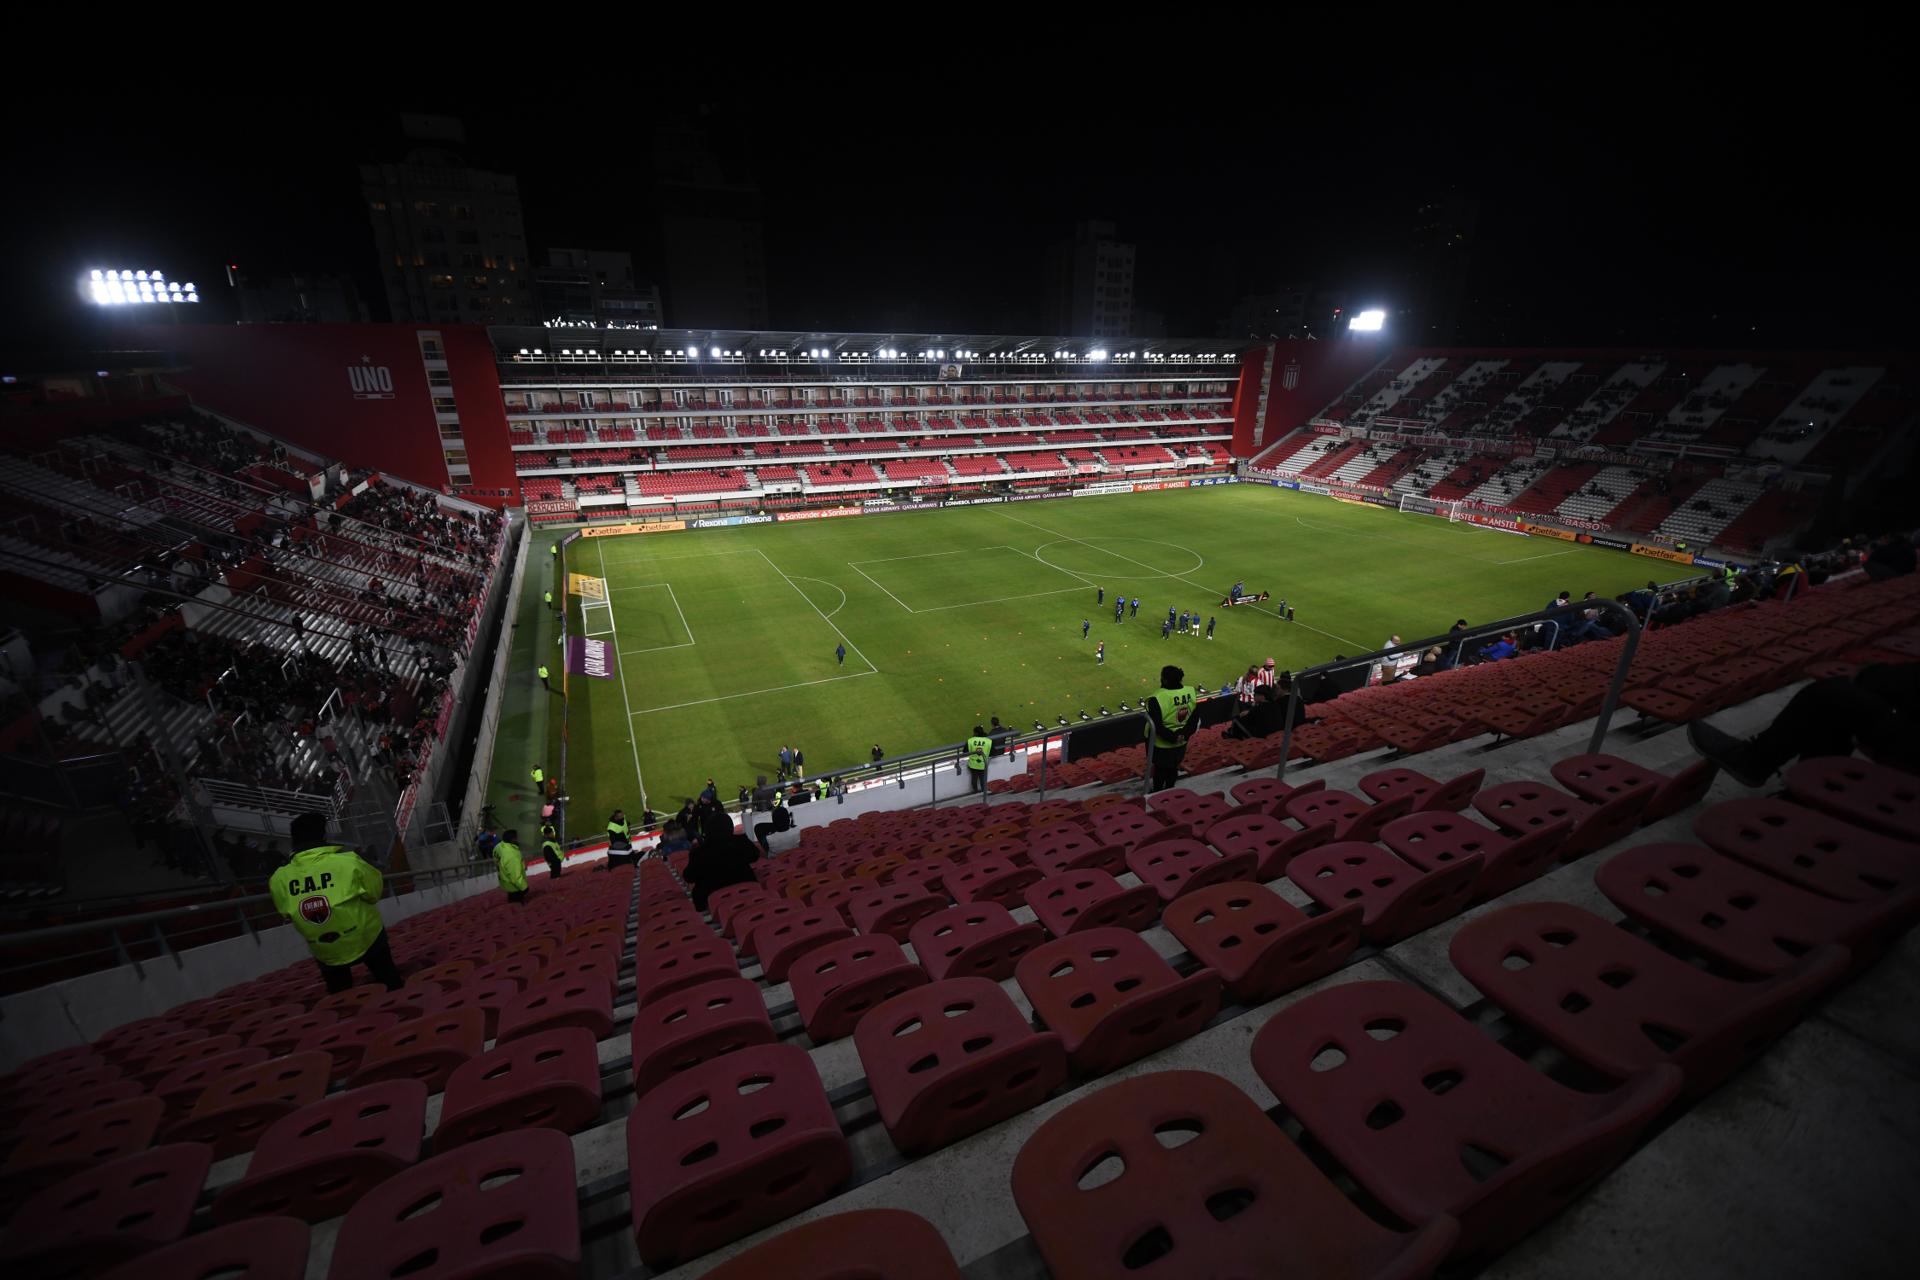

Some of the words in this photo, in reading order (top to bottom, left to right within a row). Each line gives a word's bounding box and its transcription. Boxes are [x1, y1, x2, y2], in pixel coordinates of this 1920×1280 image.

[347, 366, 393, 393] UNO
[1334, 490, 1362, 501] Santander
[945, 499, 970, 507] CONMEBOL
[971, 497, 1003, 505] LIBERTADORES
[827, 507, 861, 517] Santander
[863, 506, 880, 514] QATAR
[880, 505, 900, 513] AIRWAYS
[743, 514, 772, 524] Rexona
[785, 511, 820, 521] Santander
[698, 518, 728, 528] Rexona
[1489, 518, 1518, 530] AMSTEL
[1565, 519, 1600, 531] BASSO
[1593, 538, 1627, 549] mastercard
[1644, 547, 1677, 560] betfair
[289, 872, 334, 896] C.A.P.
